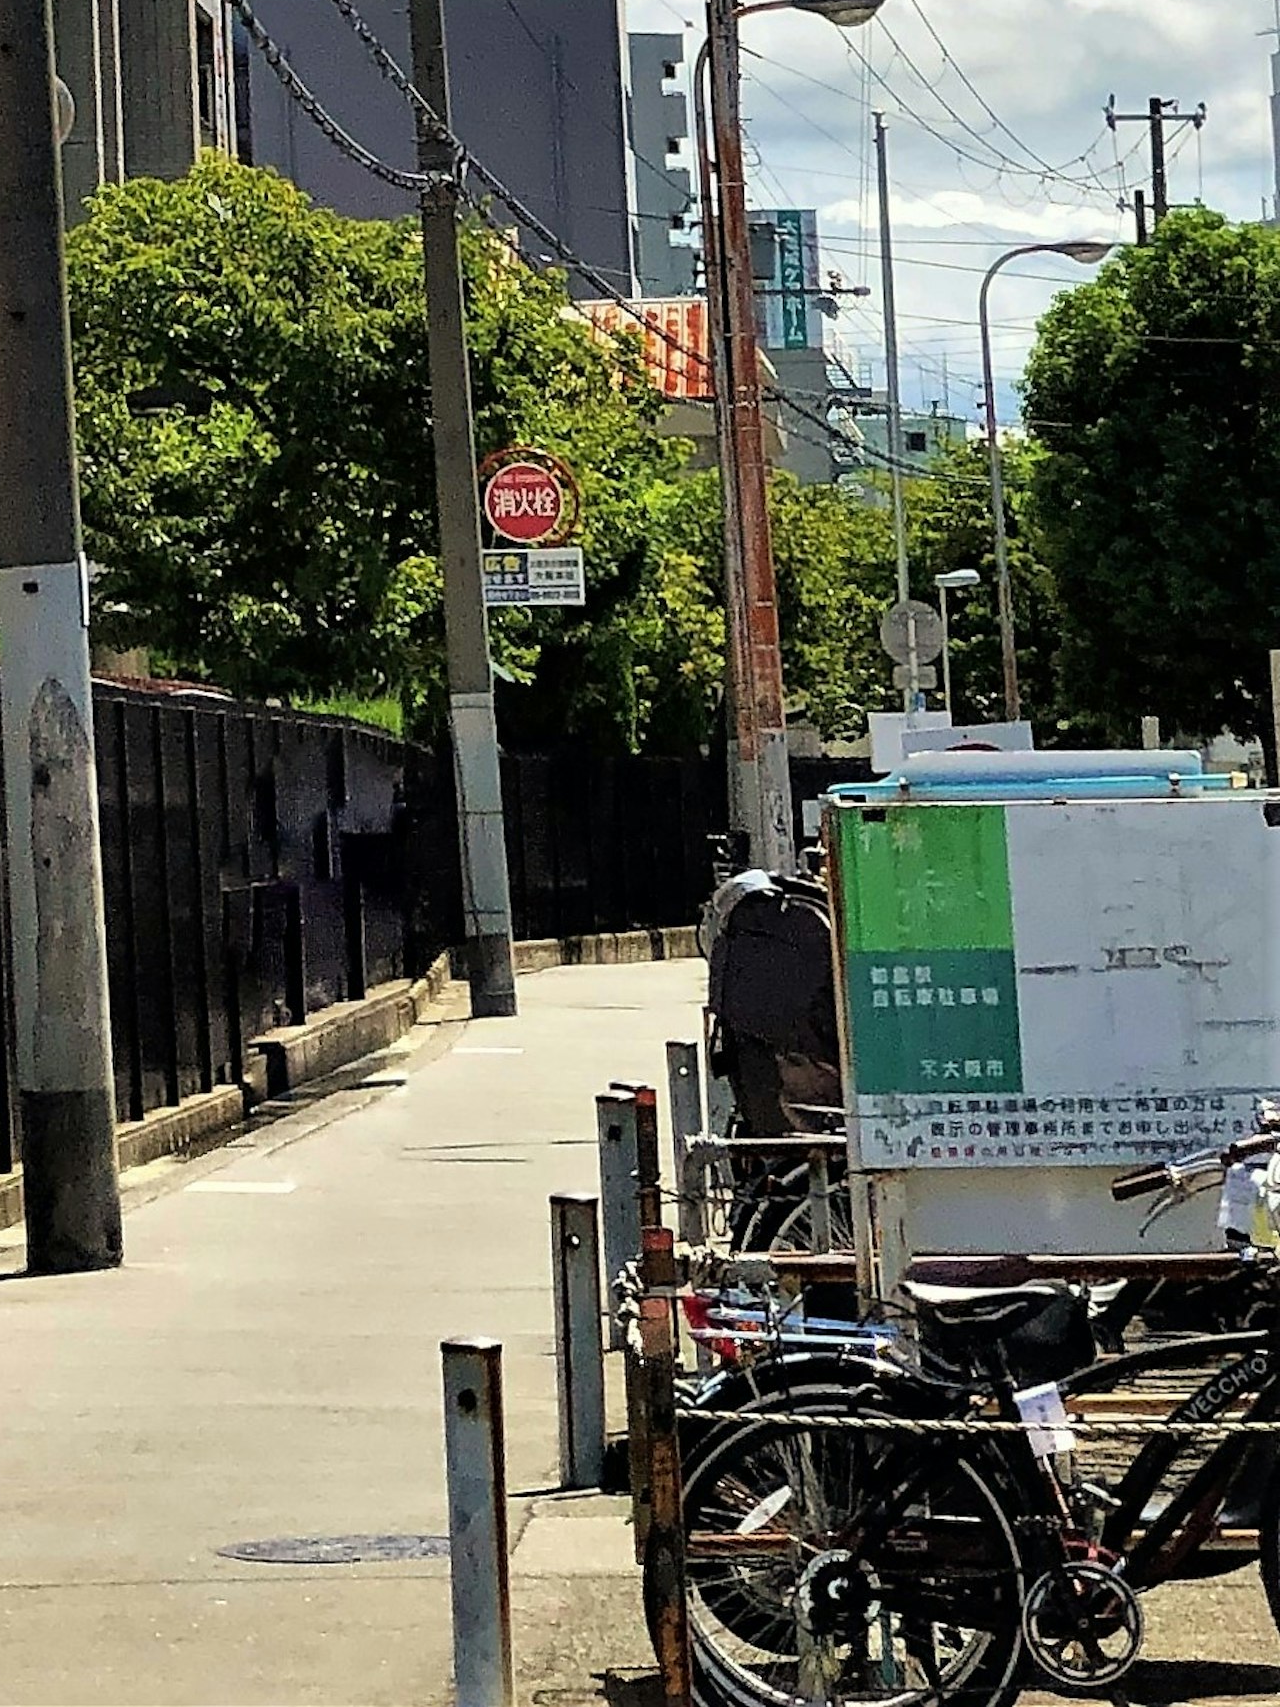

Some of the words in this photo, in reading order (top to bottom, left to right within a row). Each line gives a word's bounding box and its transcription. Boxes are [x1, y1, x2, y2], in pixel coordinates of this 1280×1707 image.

[494, 486, 557, 518] 消火栓
[873, 987, 1000, 1007] 自転車駐車場
[1183, 1356, 1268, 1420] VECCHIO
